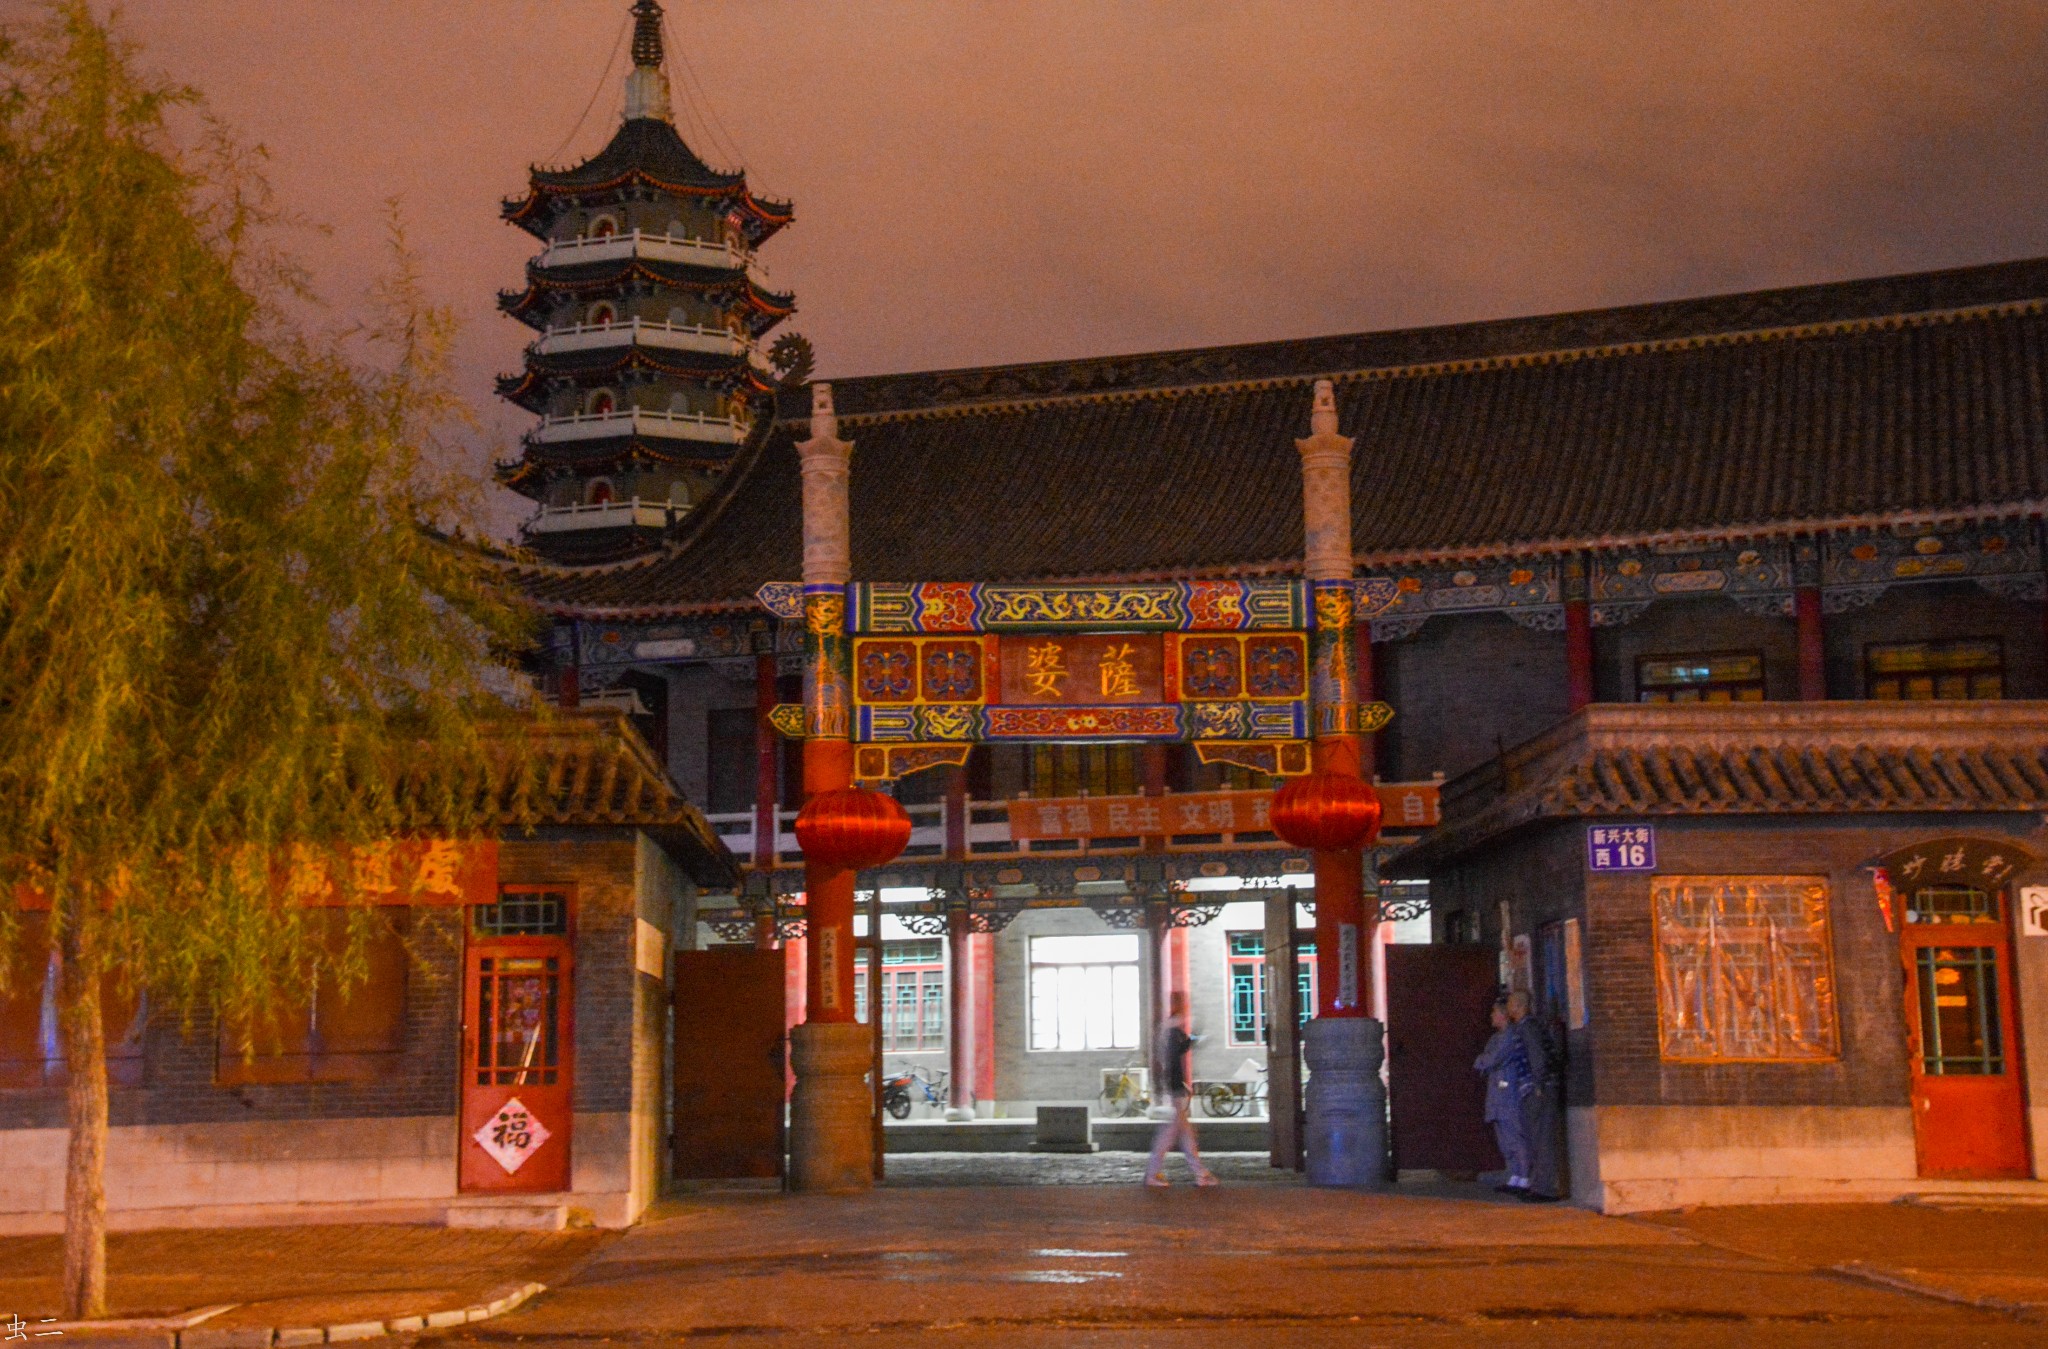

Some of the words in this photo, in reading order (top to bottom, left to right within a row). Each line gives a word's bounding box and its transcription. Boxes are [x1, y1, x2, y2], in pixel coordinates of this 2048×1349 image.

[1107, 802, 1162, 831] 民主
[1180, 799, 1235, 830] 文明
[1593, 828, 1649, 845] 新兴大街
[1595, 848, 1610, 867] 西
[1618, 845, 1646, 866] 16
[492, 1112, 530, 1149] 福
